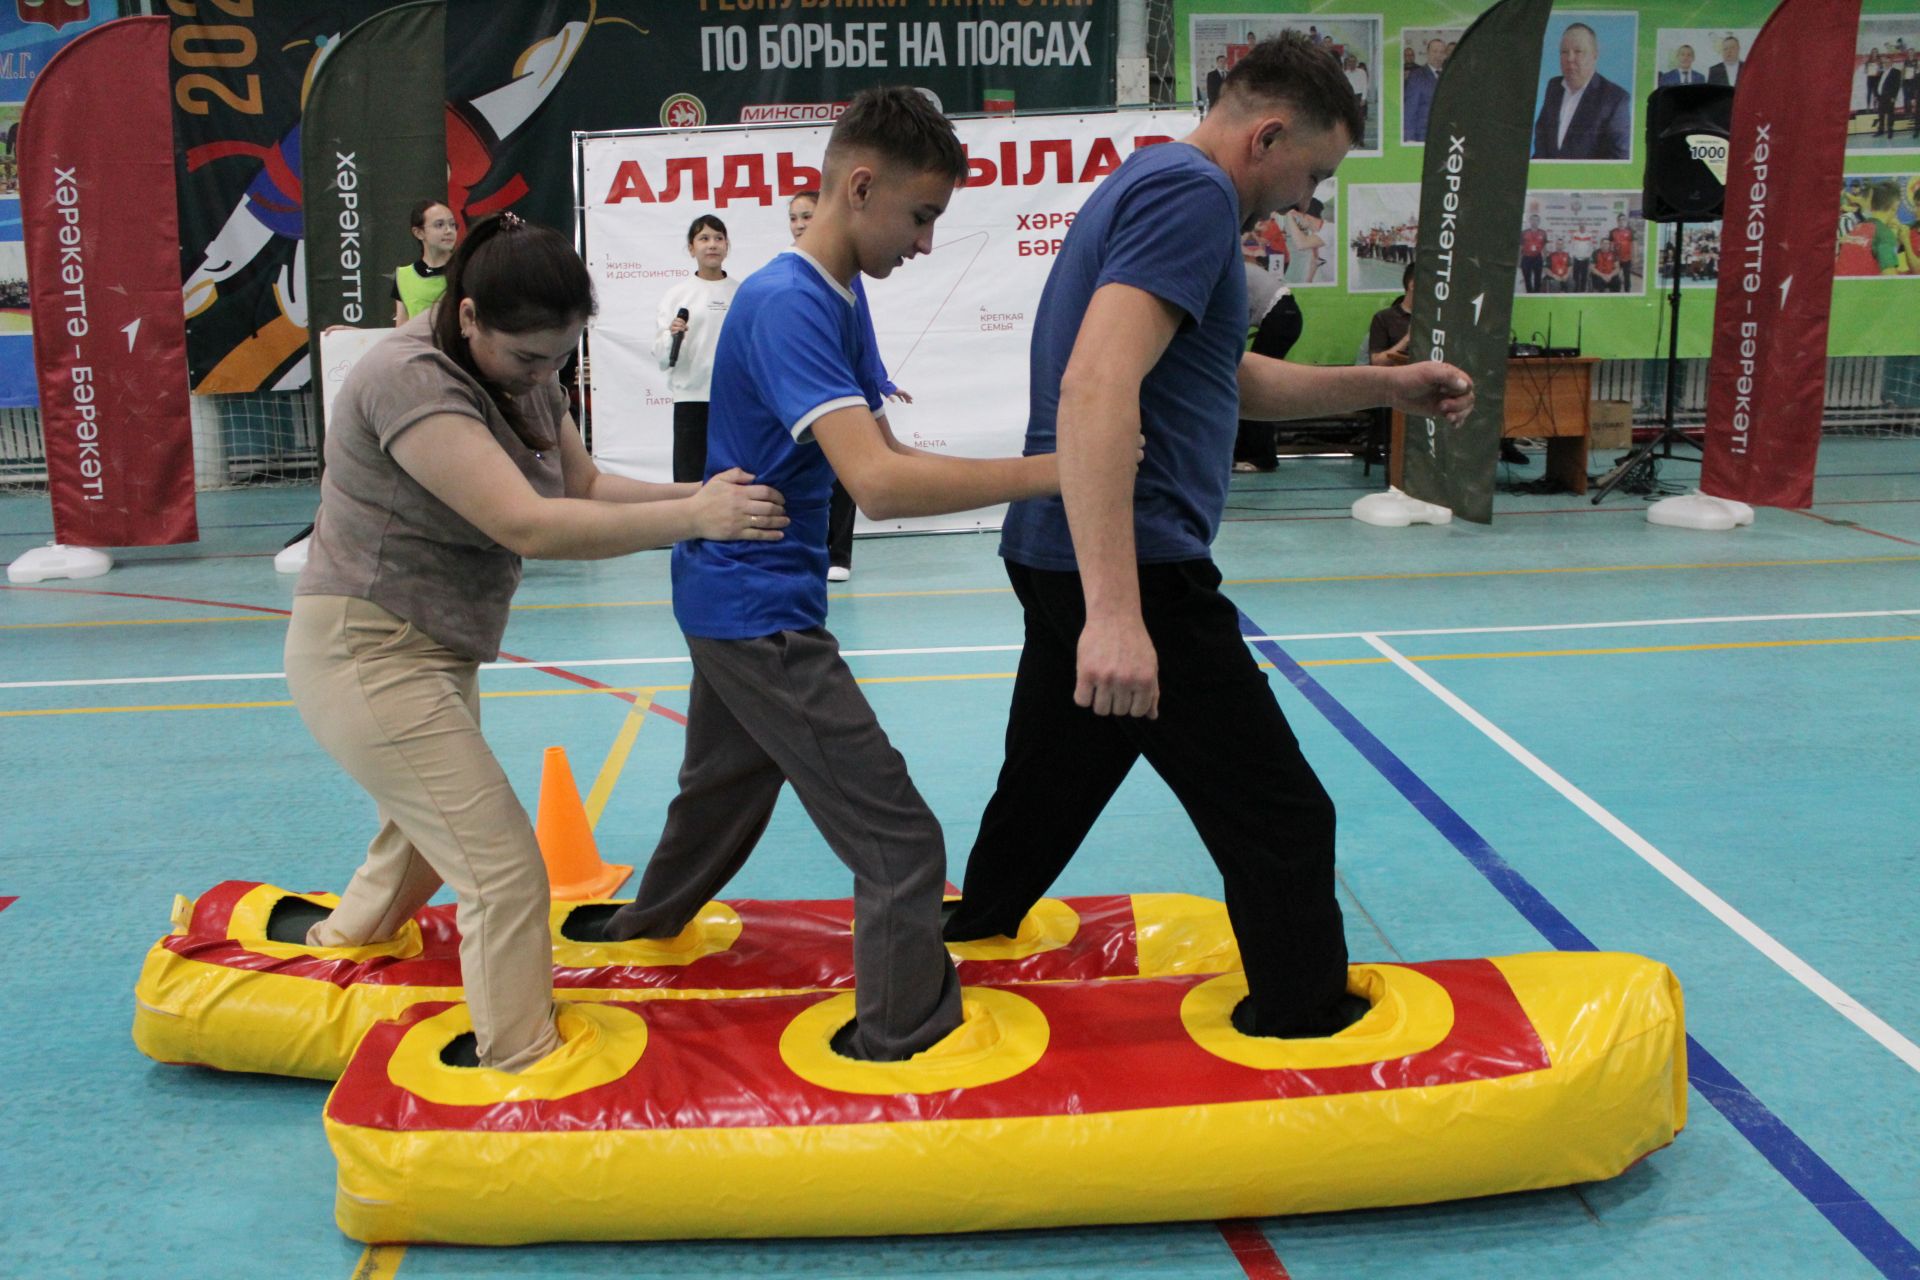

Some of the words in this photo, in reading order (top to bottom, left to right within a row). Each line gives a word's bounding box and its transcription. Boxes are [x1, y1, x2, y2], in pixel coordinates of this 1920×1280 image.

[702, 26, 748, 71] ПО
[759, 23, 888, 70] БОРЬБЕ
[900, 22, 946, 67] НА
[957, 20, 1092, 67] ПОЯСАХ
[743, 105, 850, 121] МИНСПОР
[1691, 146, 1726, 159] 1000
[1743, 125, 1770, 293] ХӘРӘКӘТТӘ
[1434, 135, 1466, 301] ХӘРӘКӘТТӘ
[336, 151, 363, 323] ХӘРӘКӘТТӘ
[54, 167, 89, 337] ХӘРӘКӘТТӘ
[606, 262, 642, 271] ЖИЗНЬ
[606, 271, 615, 280] И
[616, 269, 690, 280] ДОСТОИНСТВО
[980, 312, 1024, 322] КРЕПКАЯ
[980, 323, 1014, 332] СЕМЬЯ
[1731, 322, 1757, 454] БӘРӘКӘТ!
[646, 397, 674, 406] ПАТР
[71, 366, 104, 501] БӘРӘКӘТ!
[914, 440, 947, 448] МЕЧТА
